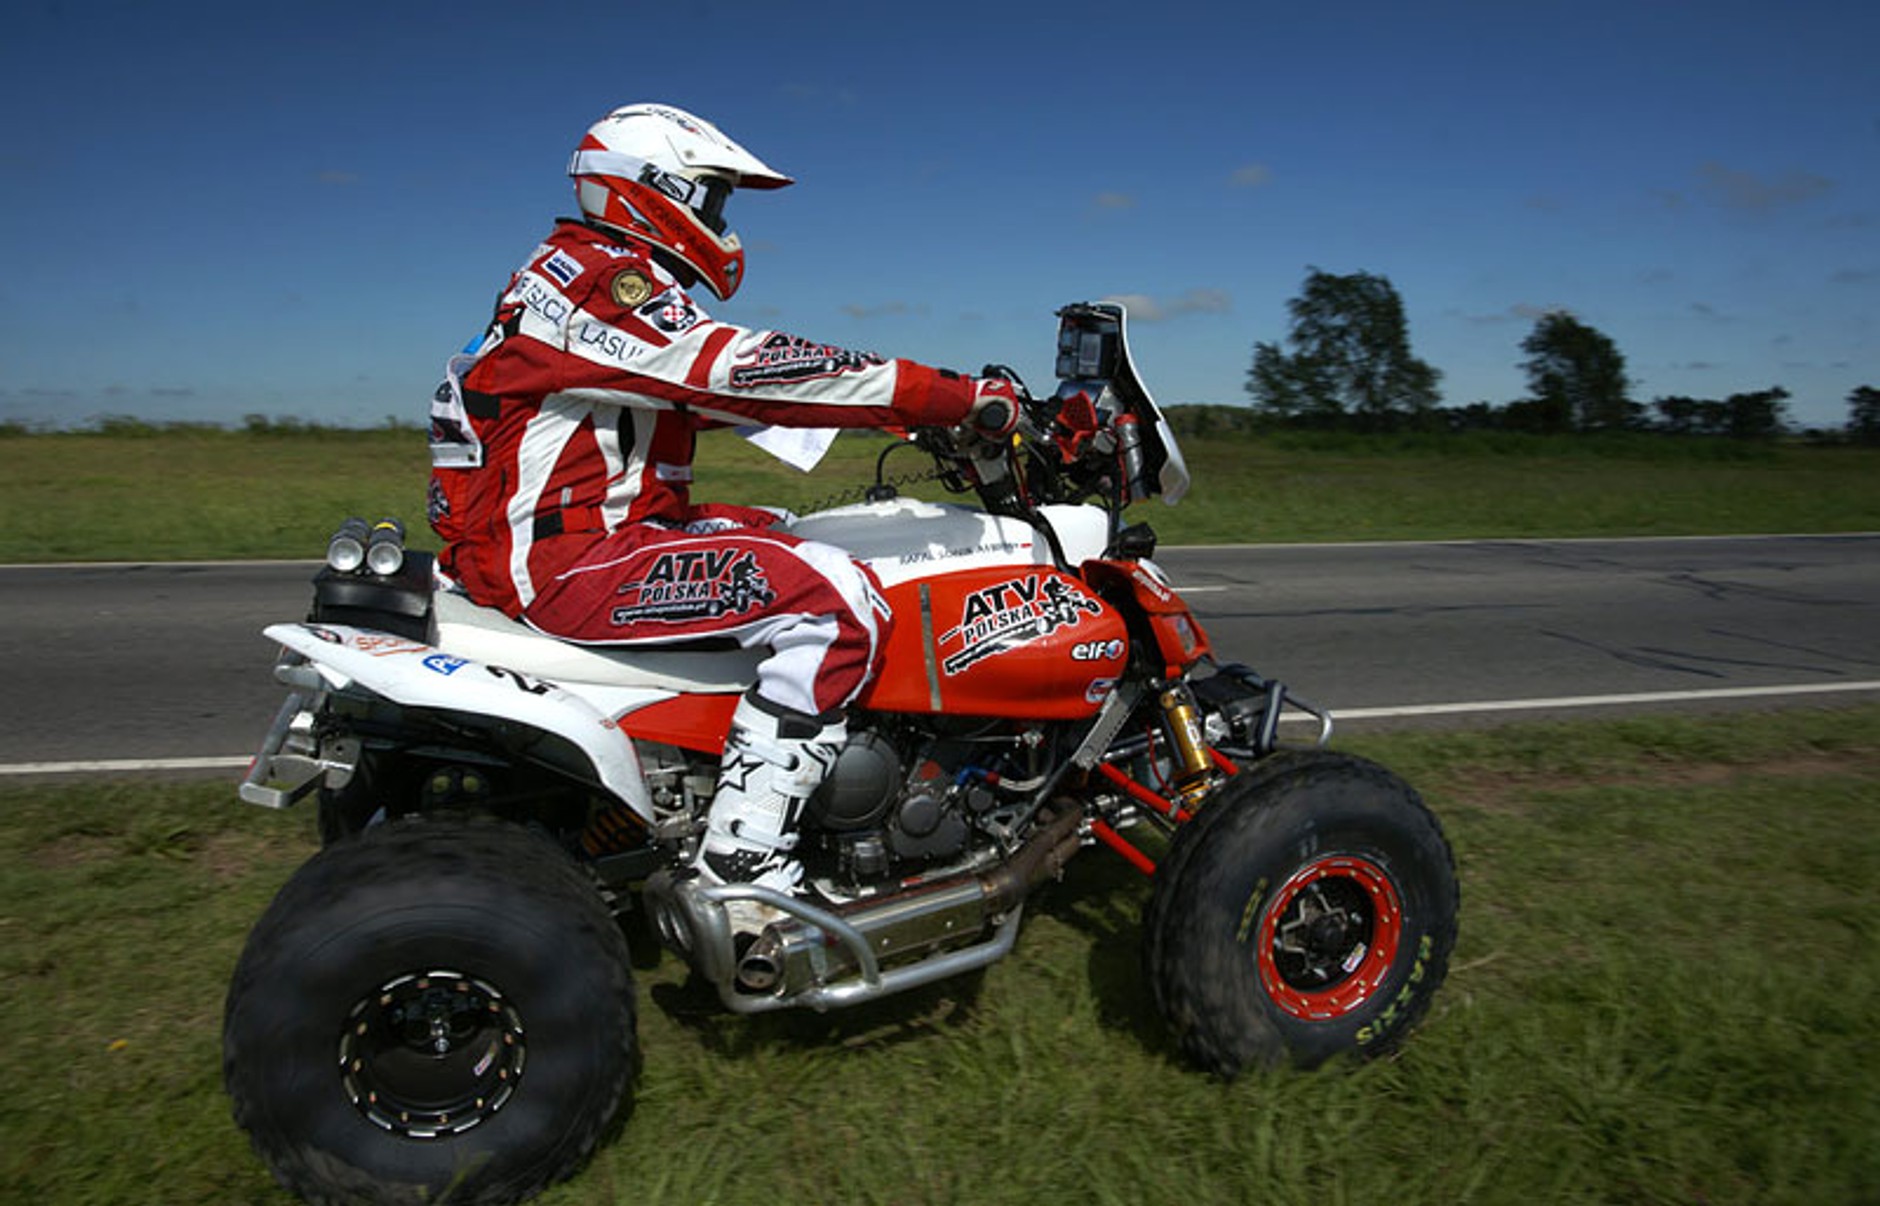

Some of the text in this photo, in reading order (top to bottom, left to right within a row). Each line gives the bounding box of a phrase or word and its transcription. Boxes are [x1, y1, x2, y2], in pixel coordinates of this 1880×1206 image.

[645, 550, 737, 584] ATV
[640, 582, 709, 602] POLSKA
[963, 576, 1036, 627] ATV
[964, 603, 1033, 645] POLSKA
[1071, 642, 1107, 660] elf
